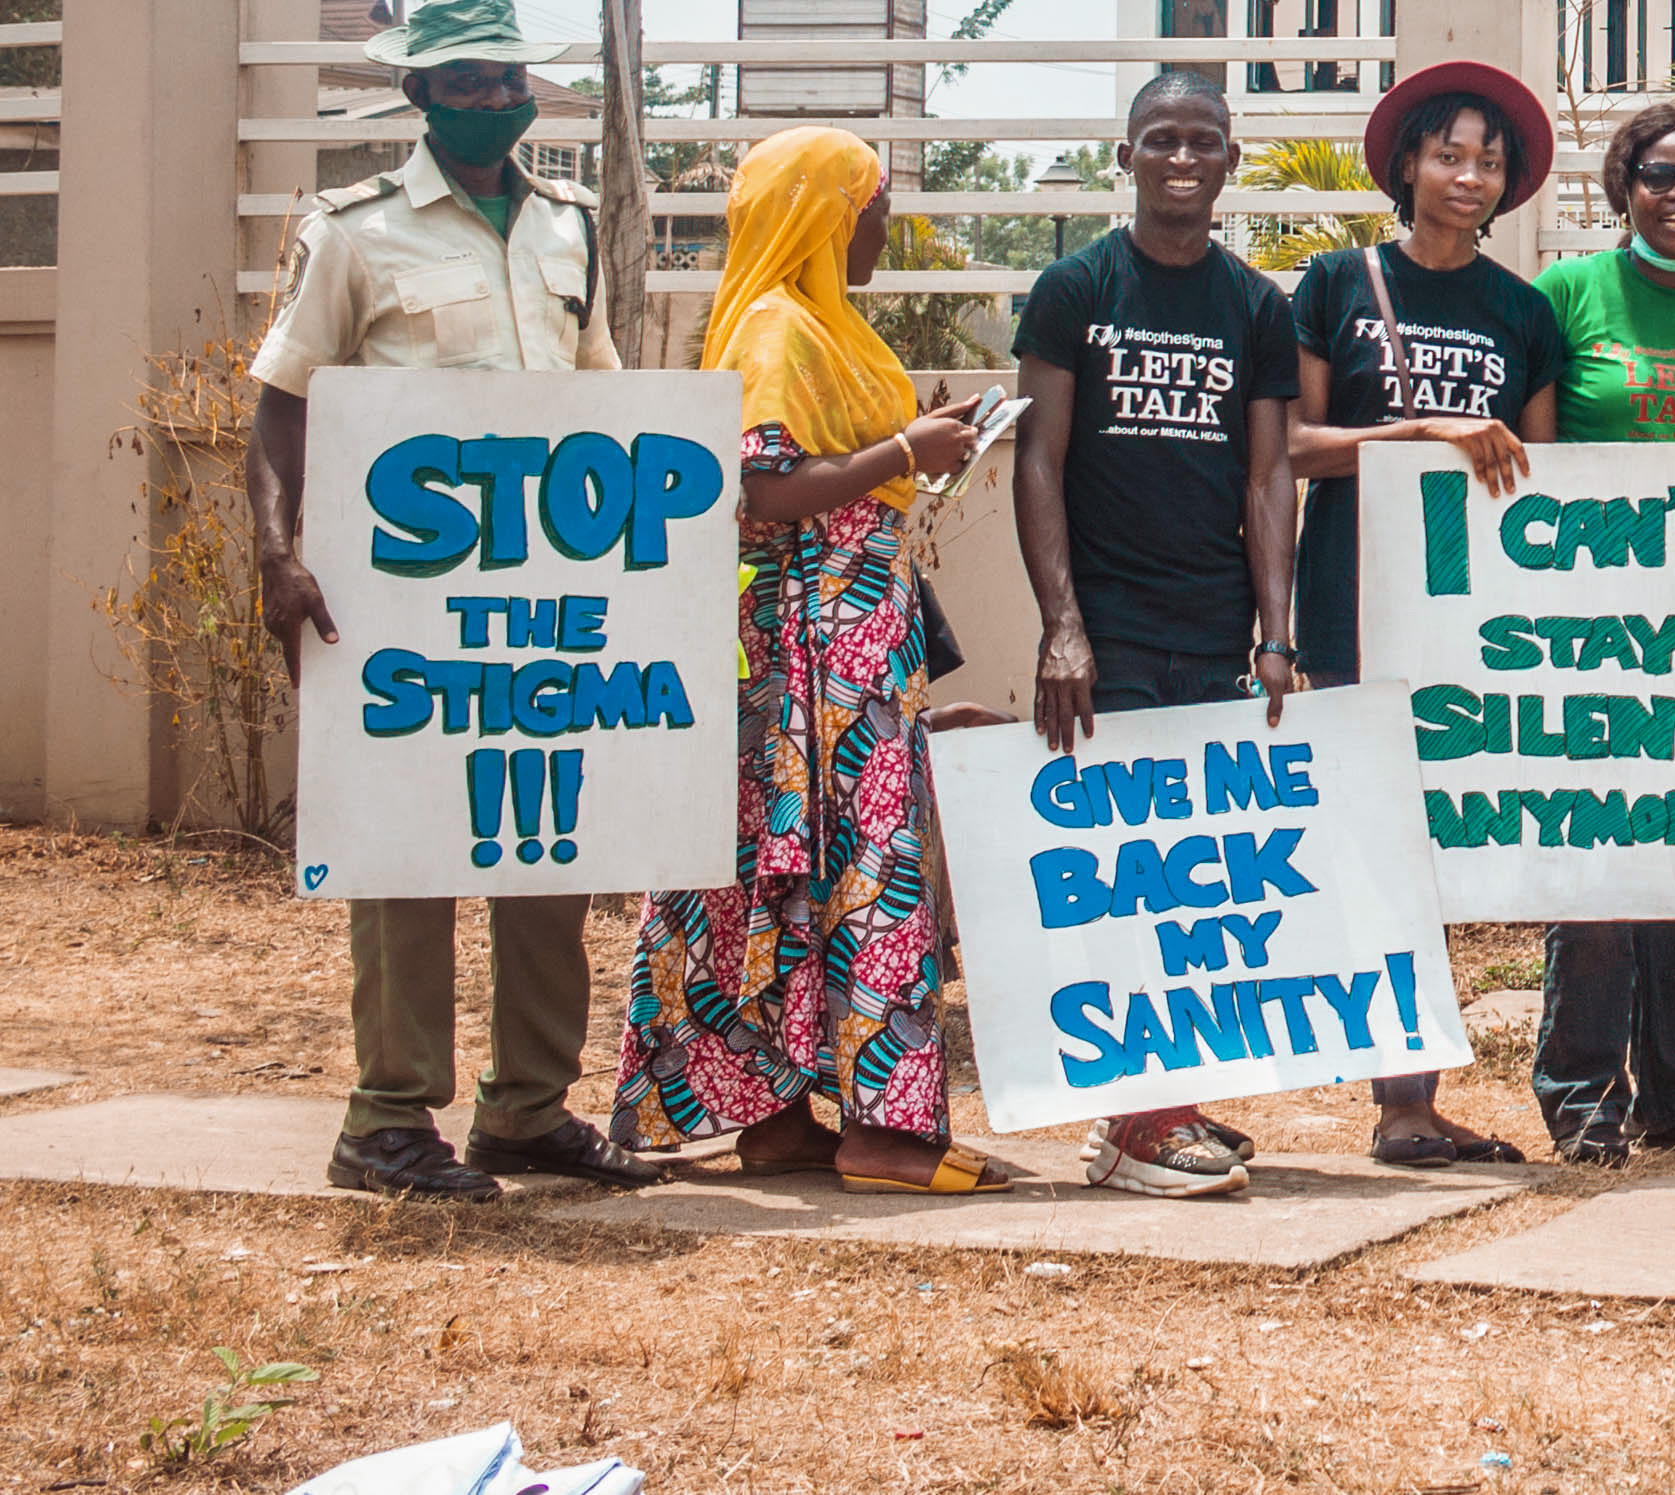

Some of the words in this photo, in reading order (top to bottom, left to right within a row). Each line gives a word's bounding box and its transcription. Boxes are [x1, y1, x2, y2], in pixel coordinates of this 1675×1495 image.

[1379, 341, 1506, 386] LET'S
[1396, 322, 1495, 348] #stopthestigma
[1106, 348, 1235, 392] LET'S
[1384, 376, 1499, 418] TALK
[1111, 386, 1223, 426] TALK
[1140, 427, 1159, 436] our
[1160, 426, 1199, 440] MENTAL
[1200, 431, 1229, 442] HEALTH
[366, 432, 723, 576] STOP
[1420, 470, 1469, 596] I
[447, 595, 607, 650] THE
[362, 648, 695, 737] STIGMA
[465, 748, 583, 866] !!!
[1030, 753, 1192, 829] GIVE
[1204, 741, 1319, 813] ME
[1028, 827, 1319, 927] BACK
[1155, 909, 1282, 976] MY
[1050, 951, 1420, 1088] SANITY!
